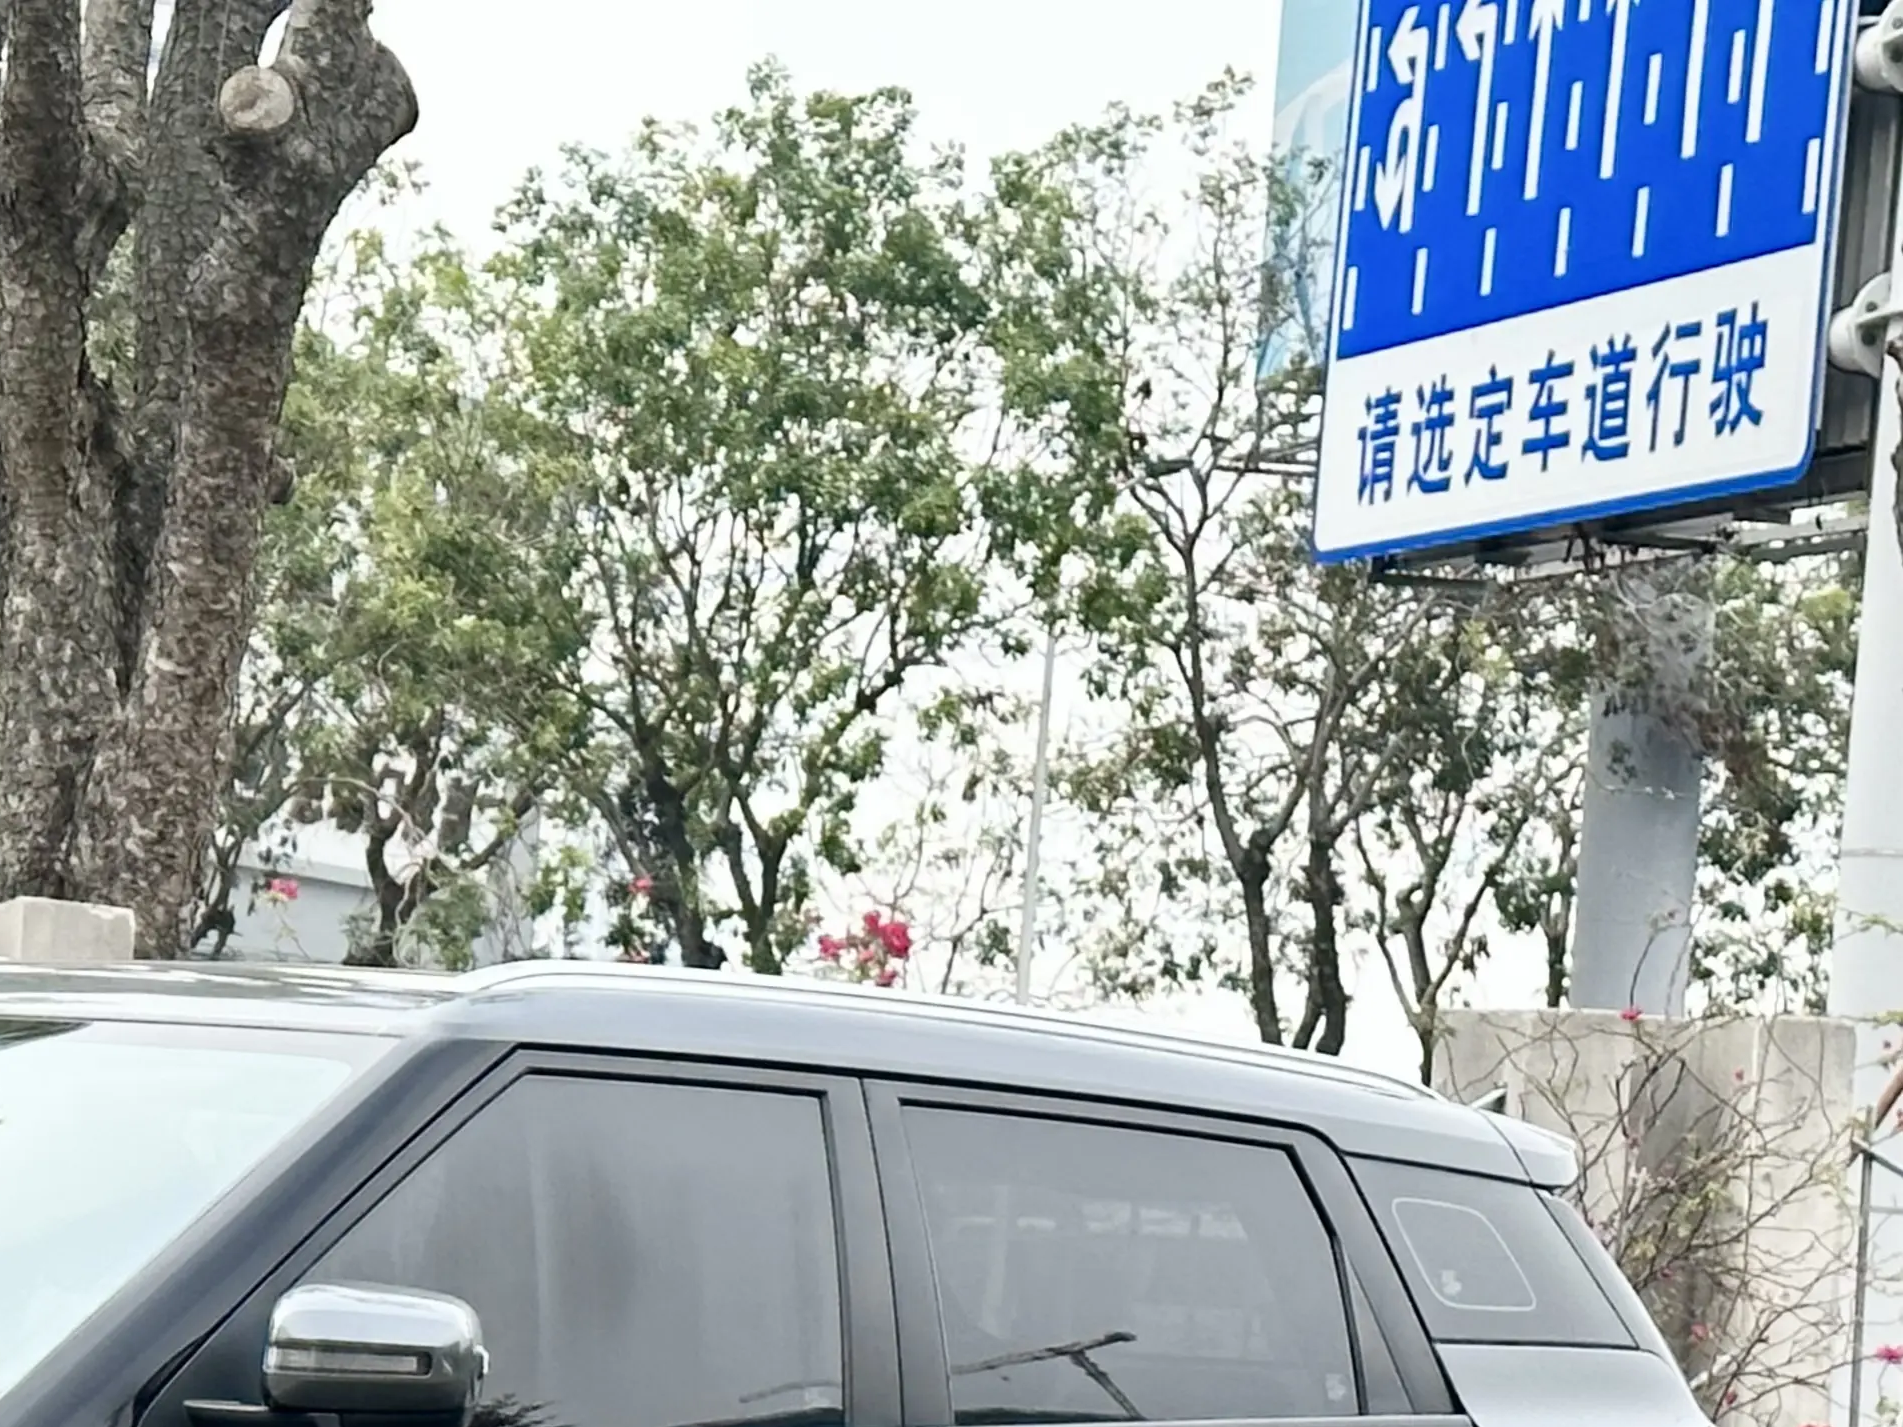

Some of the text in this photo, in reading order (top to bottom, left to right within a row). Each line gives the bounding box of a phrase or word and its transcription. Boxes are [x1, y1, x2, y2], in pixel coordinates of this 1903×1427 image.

[1357, 302, 1769, 505] 请选定车道行驶
